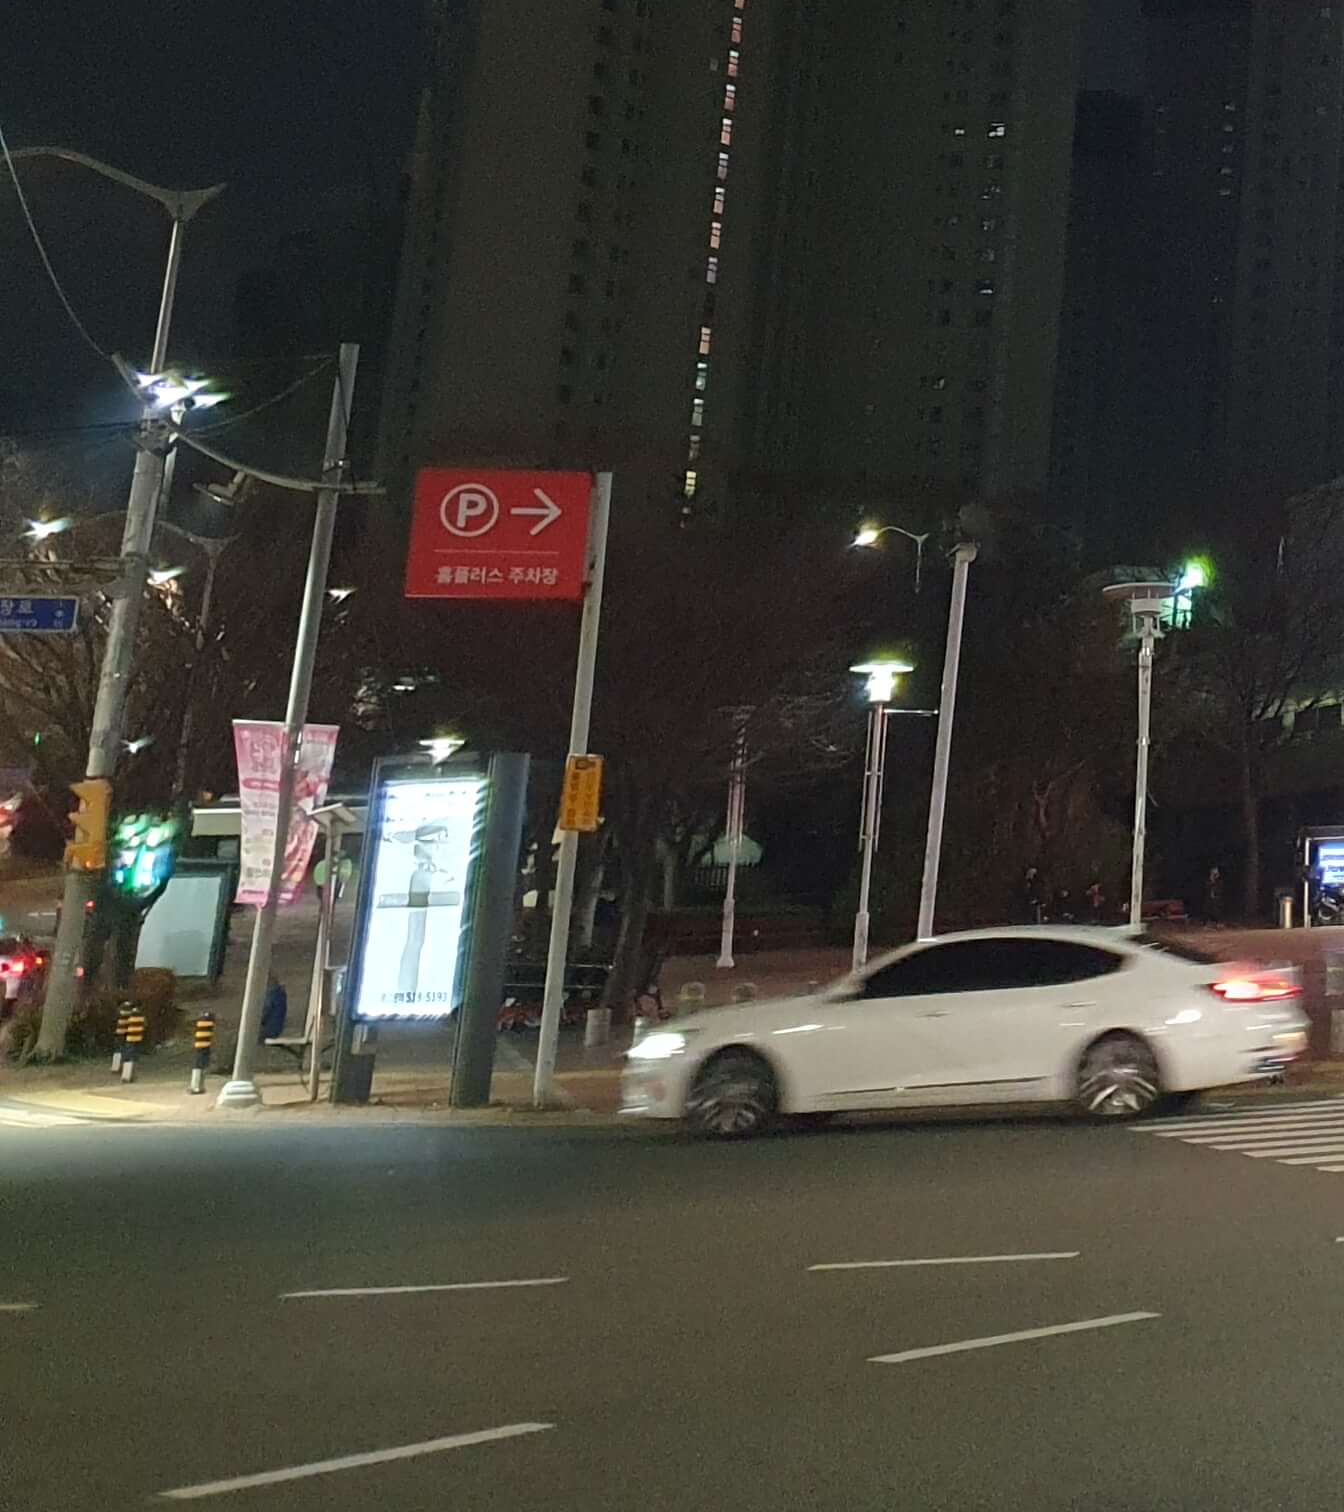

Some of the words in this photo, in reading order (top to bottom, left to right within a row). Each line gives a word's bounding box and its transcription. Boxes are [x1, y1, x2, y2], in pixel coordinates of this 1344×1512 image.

[456, 492, 488, 528] P
[436, 565, 504, 585] 홈플러스
[508, 566, 559, 585] 주차장
